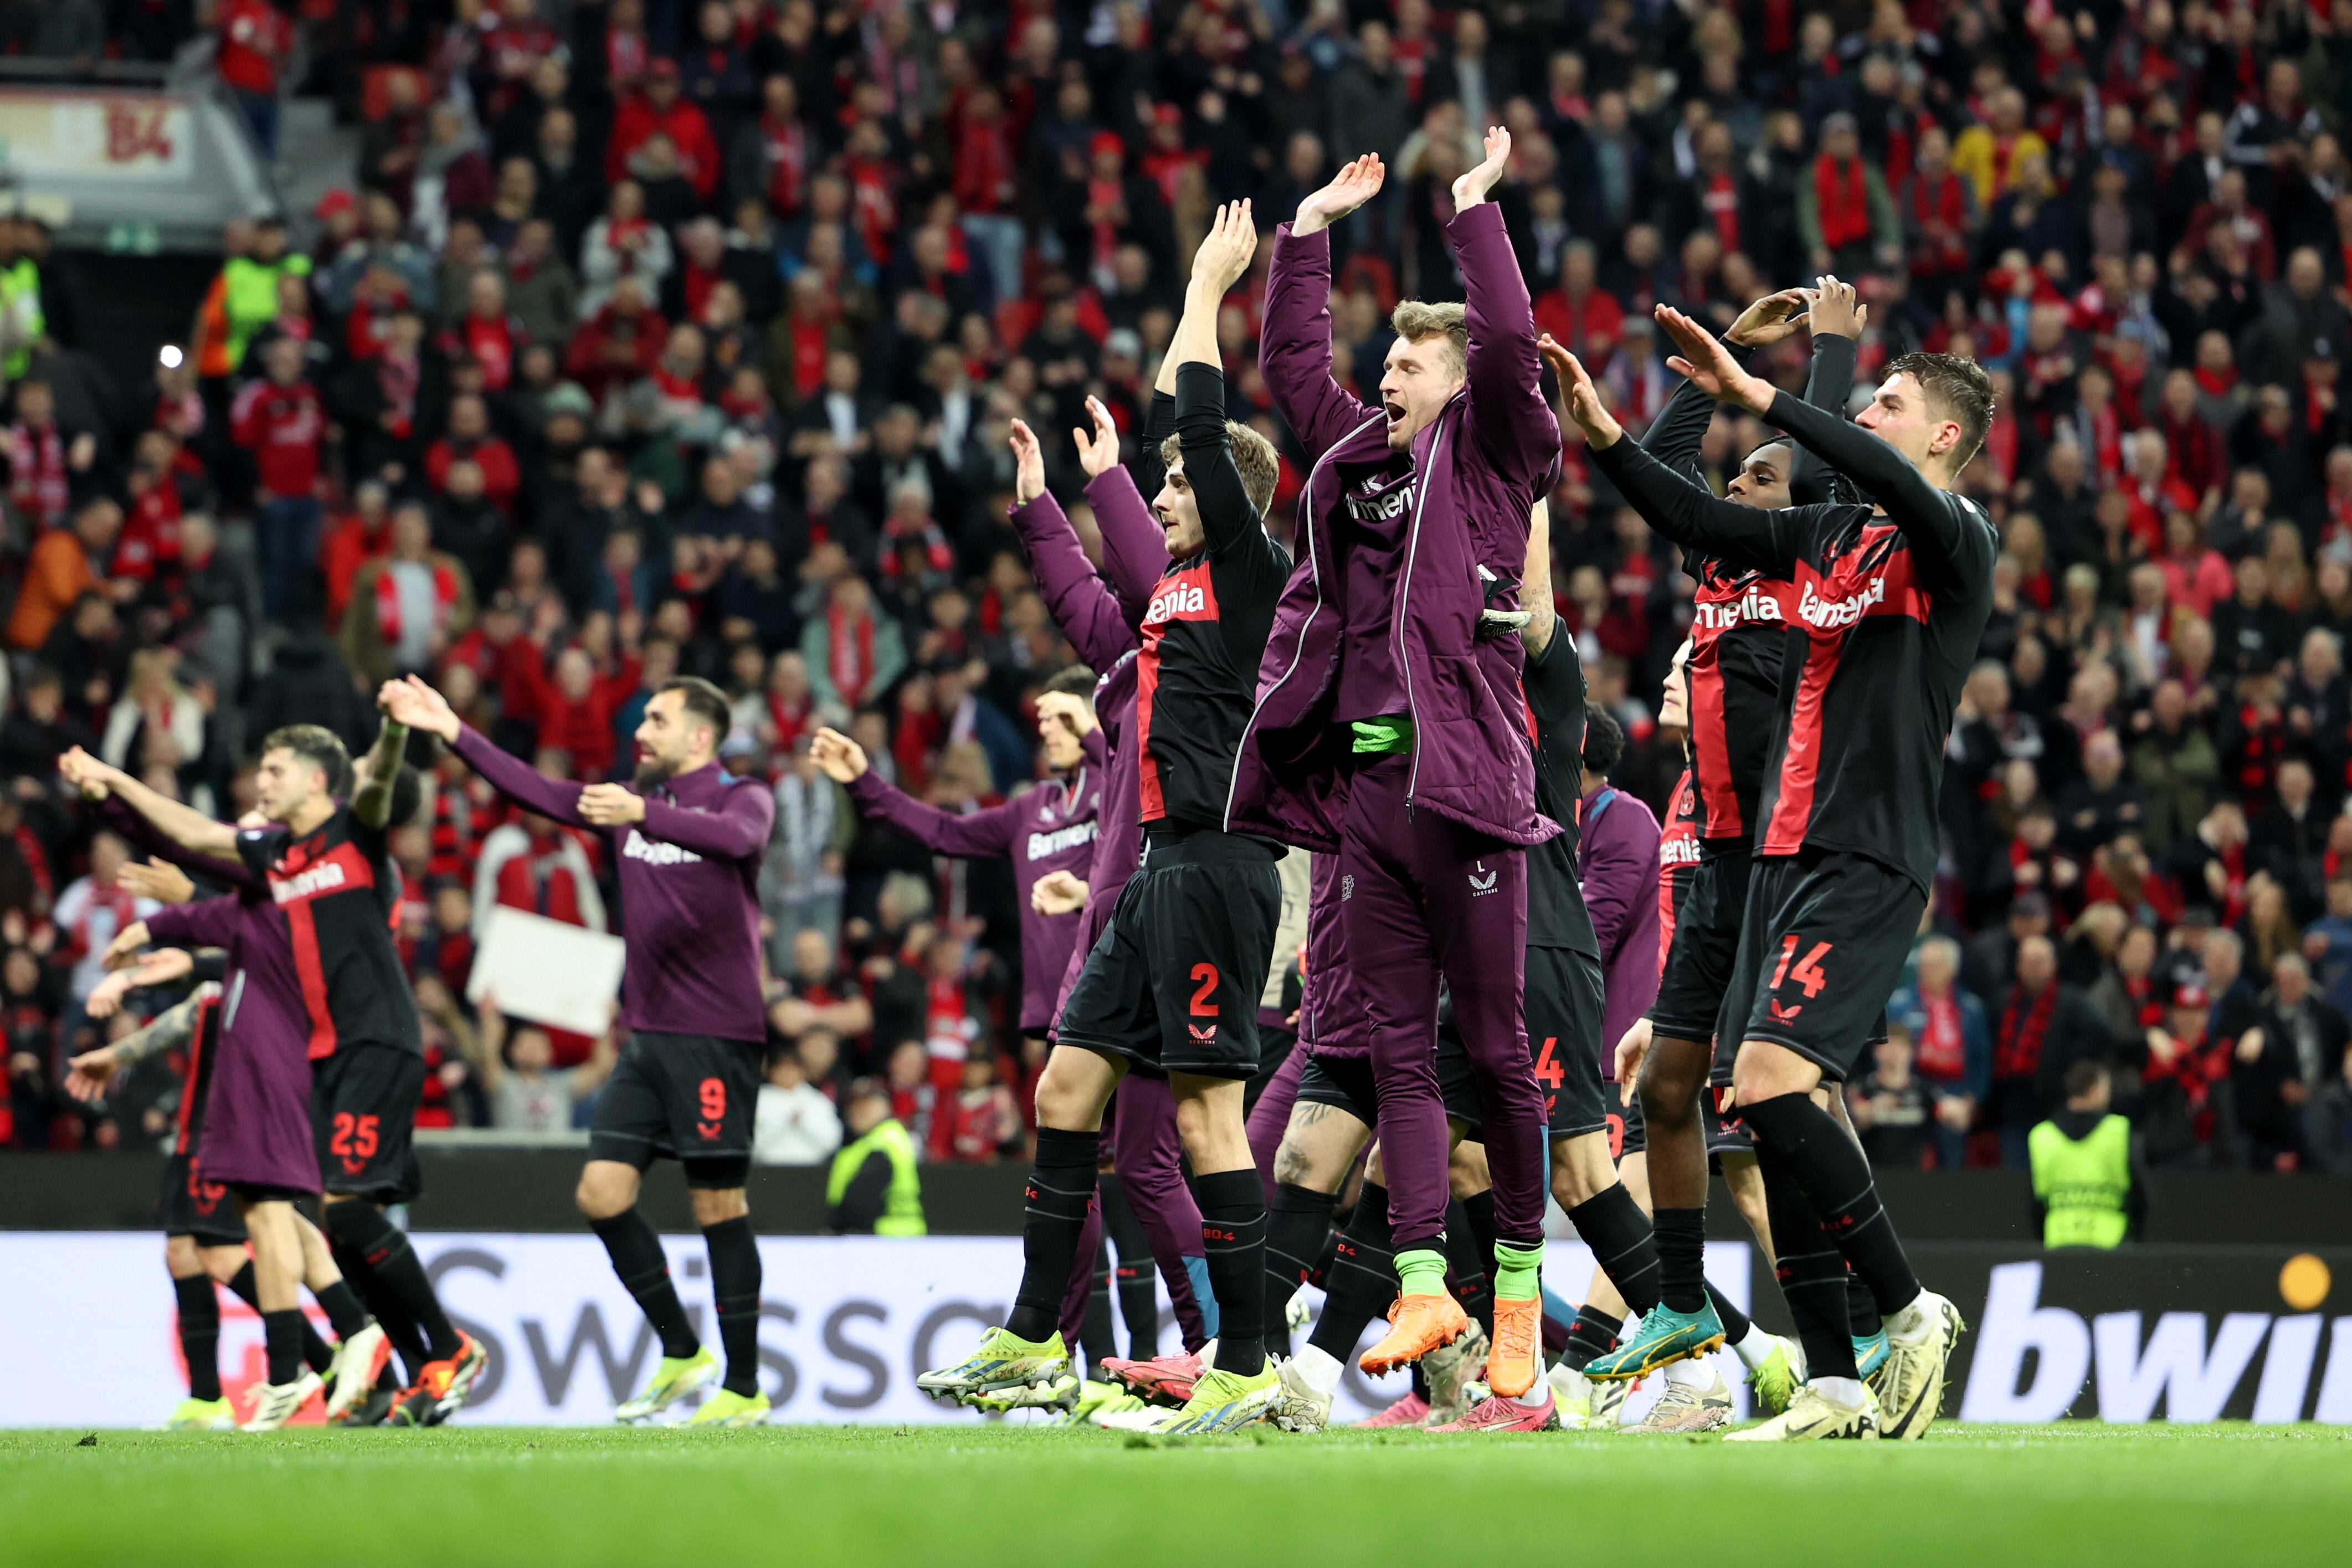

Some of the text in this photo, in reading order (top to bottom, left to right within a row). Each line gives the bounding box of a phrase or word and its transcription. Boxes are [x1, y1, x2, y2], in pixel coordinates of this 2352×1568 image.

[1472, 887, 1498, 897] CASTORE
[1190, 962, 1219, 1016] 2
[1768, 934, 1833, 999] 14
[699, 1077, 727, 1121] 9
[330, 1111, 381, 1159] 25
[1959, 1253, 2352, 1424] bwi
